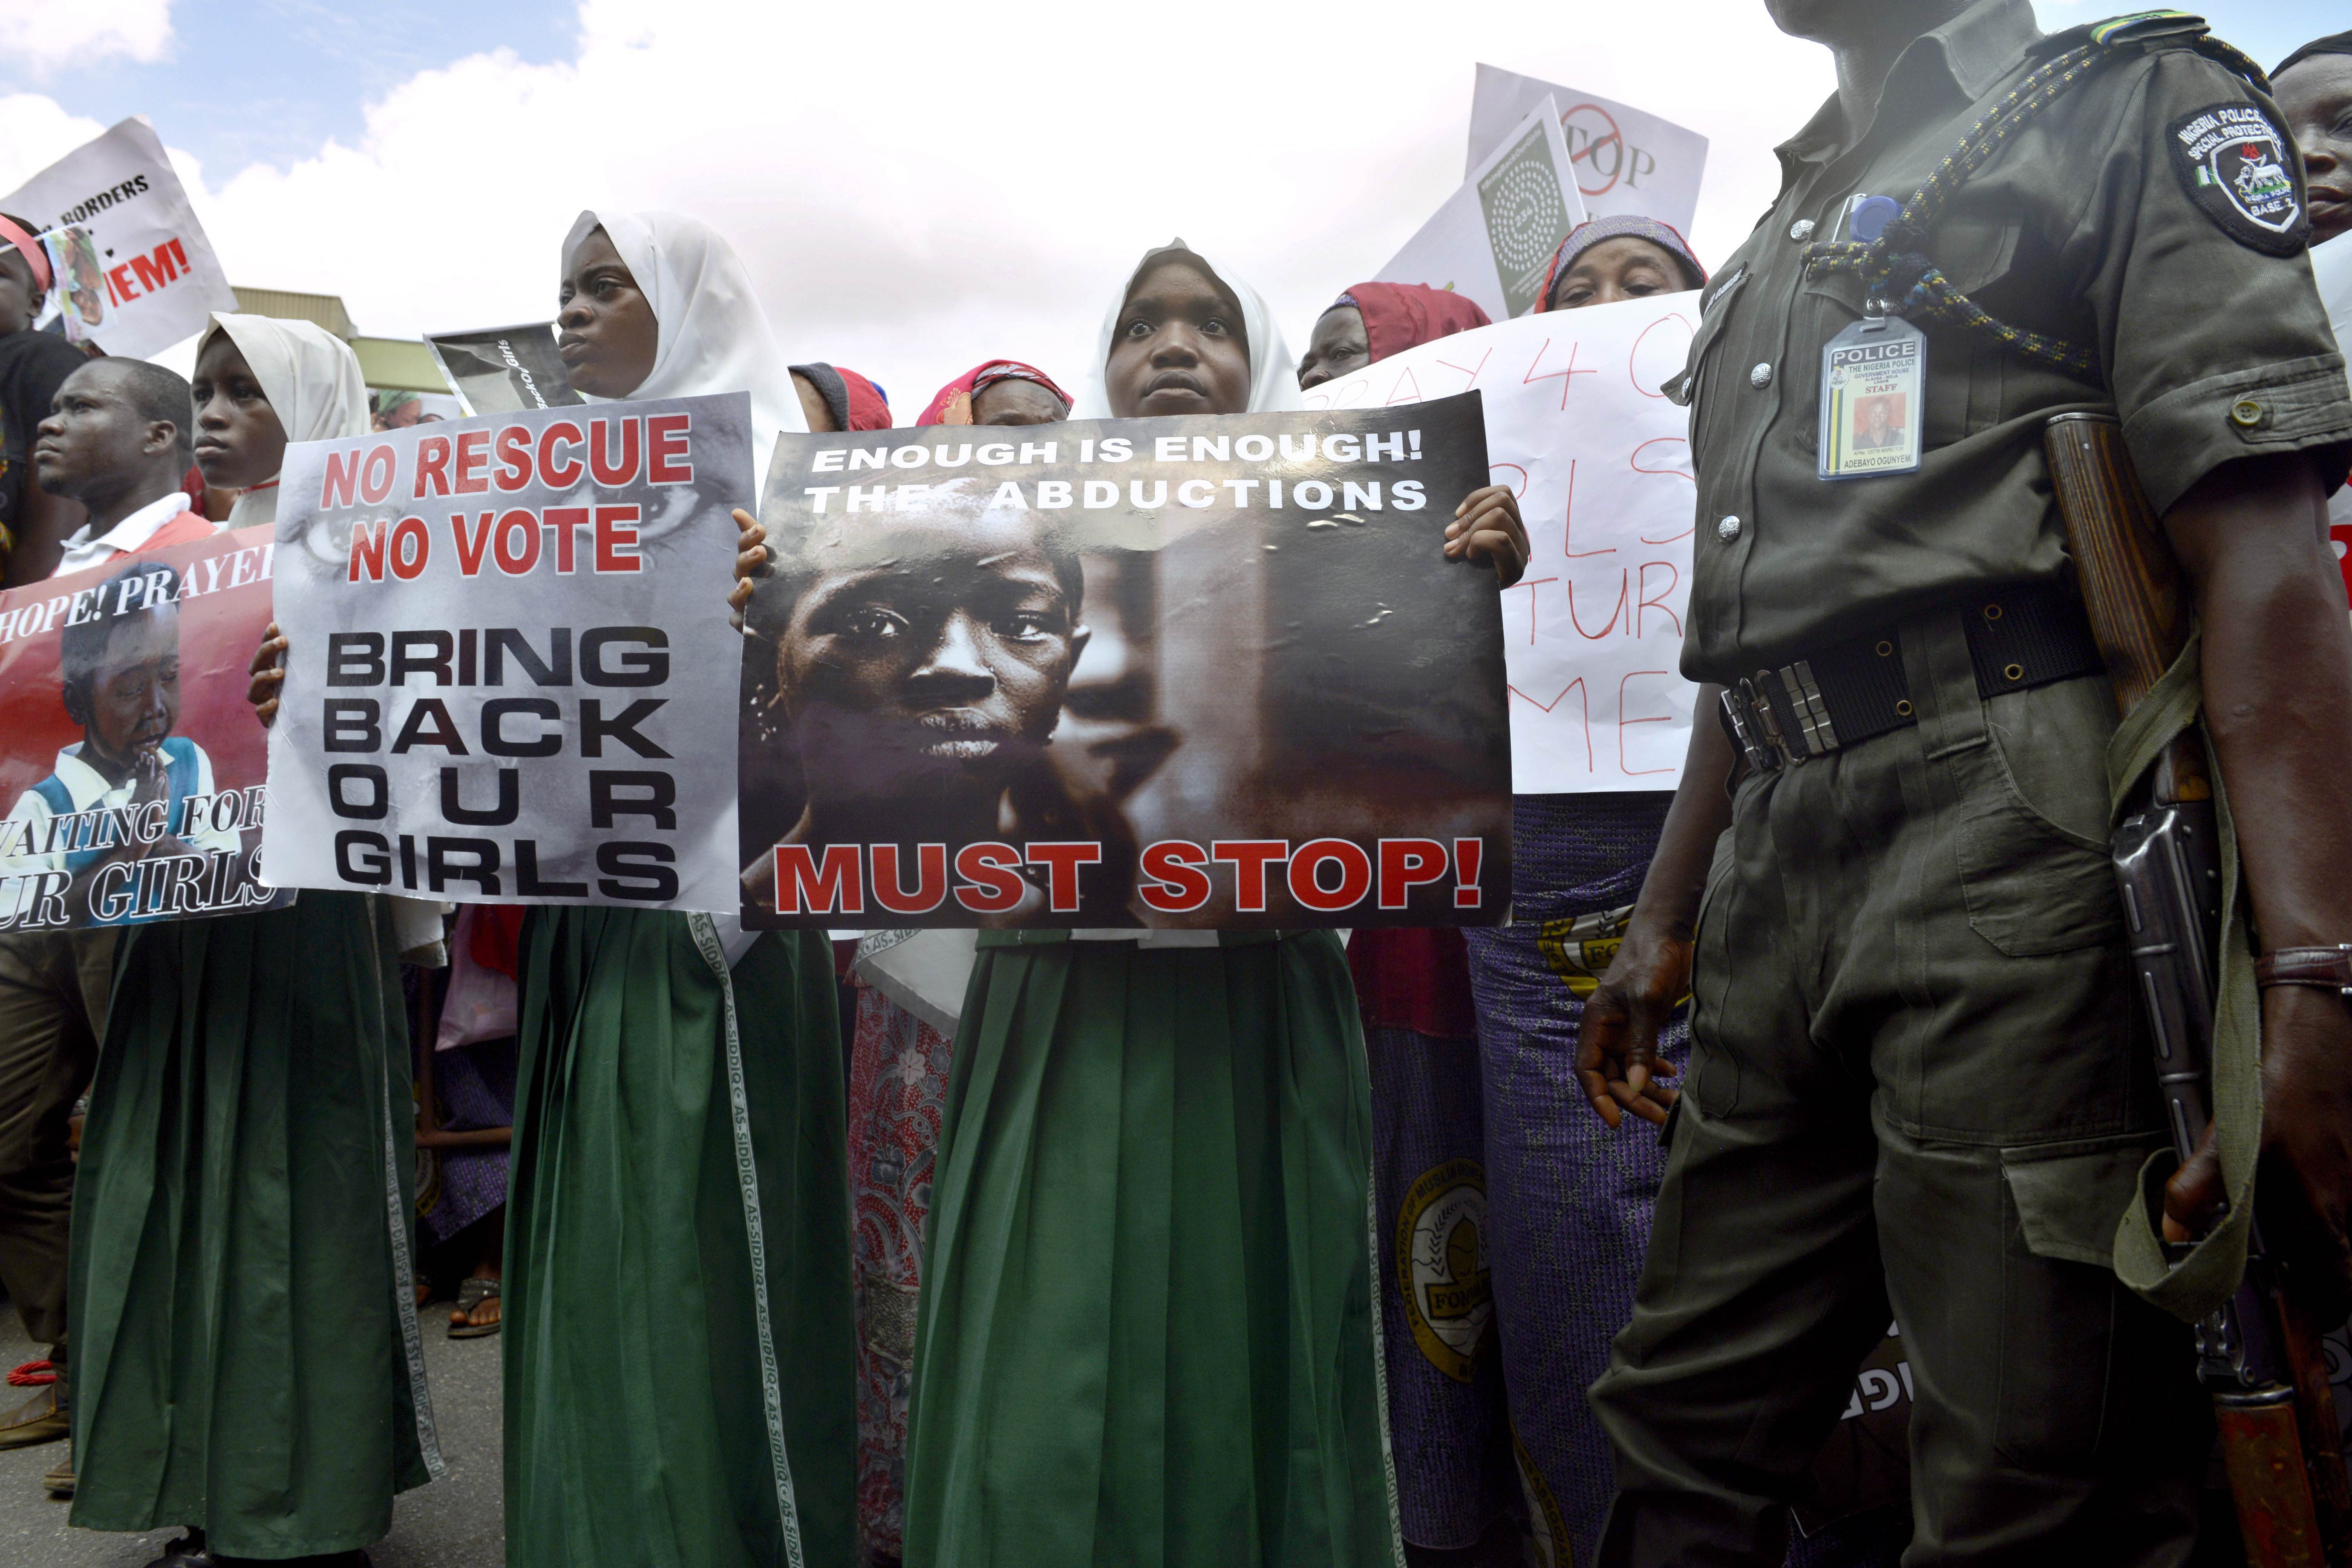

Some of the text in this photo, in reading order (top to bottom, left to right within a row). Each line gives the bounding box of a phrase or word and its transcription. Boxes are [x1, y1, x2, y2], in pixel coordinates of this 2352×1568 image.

[1560, 122, 1656, 190] TOP
[2178, 109, 2262, 145] NIGERIA POLICE
[2188, 132, 2225, 160] SPECIAL
[2251, 200, 2284, 216] BASE
[1524, 338, 1597, 411] 4
[1834, 343, 1914, 364] POLICE
[1854, 370, 1890, 379] GOVERNMENT
[1863, 362, 1891, 372] NIGERIA
[1892, 359, 1915, 368] POLICE
[1865, 383, 1898, 394] STAFF
[319, 412, 695, 512] NO RESCUE
[811, 429, 1423, 474] ENOUGH IS ENOUGH!
[1844, 458, 1876, 469] ADEBAYO
[803, 479, 1428, 514] THE ABDUCTIONS
[346, 503, 642, 584] NO VOTE
[0, 584, 108, 645] HOPE!
[326, 625, 670, 687] BRING
[323, 698, 675, 759] BACK
[327, 763, 677, 830] OUR
[334, 829, 679, 902] GIRLS
[773, 836, 1483, 915] MUST STOP!
[725, 1003, 742, 1084] AS-SIDDIQ
[735, 1105, 753, 1186] AS-SIDDIQ
[747, 1204, 764, 1286] AS-SIDDIQ
[759, 1304, 777, 1385] AS-SIDDIQ
[767, 1403, 787, 1481] AS-SIDDIQ
